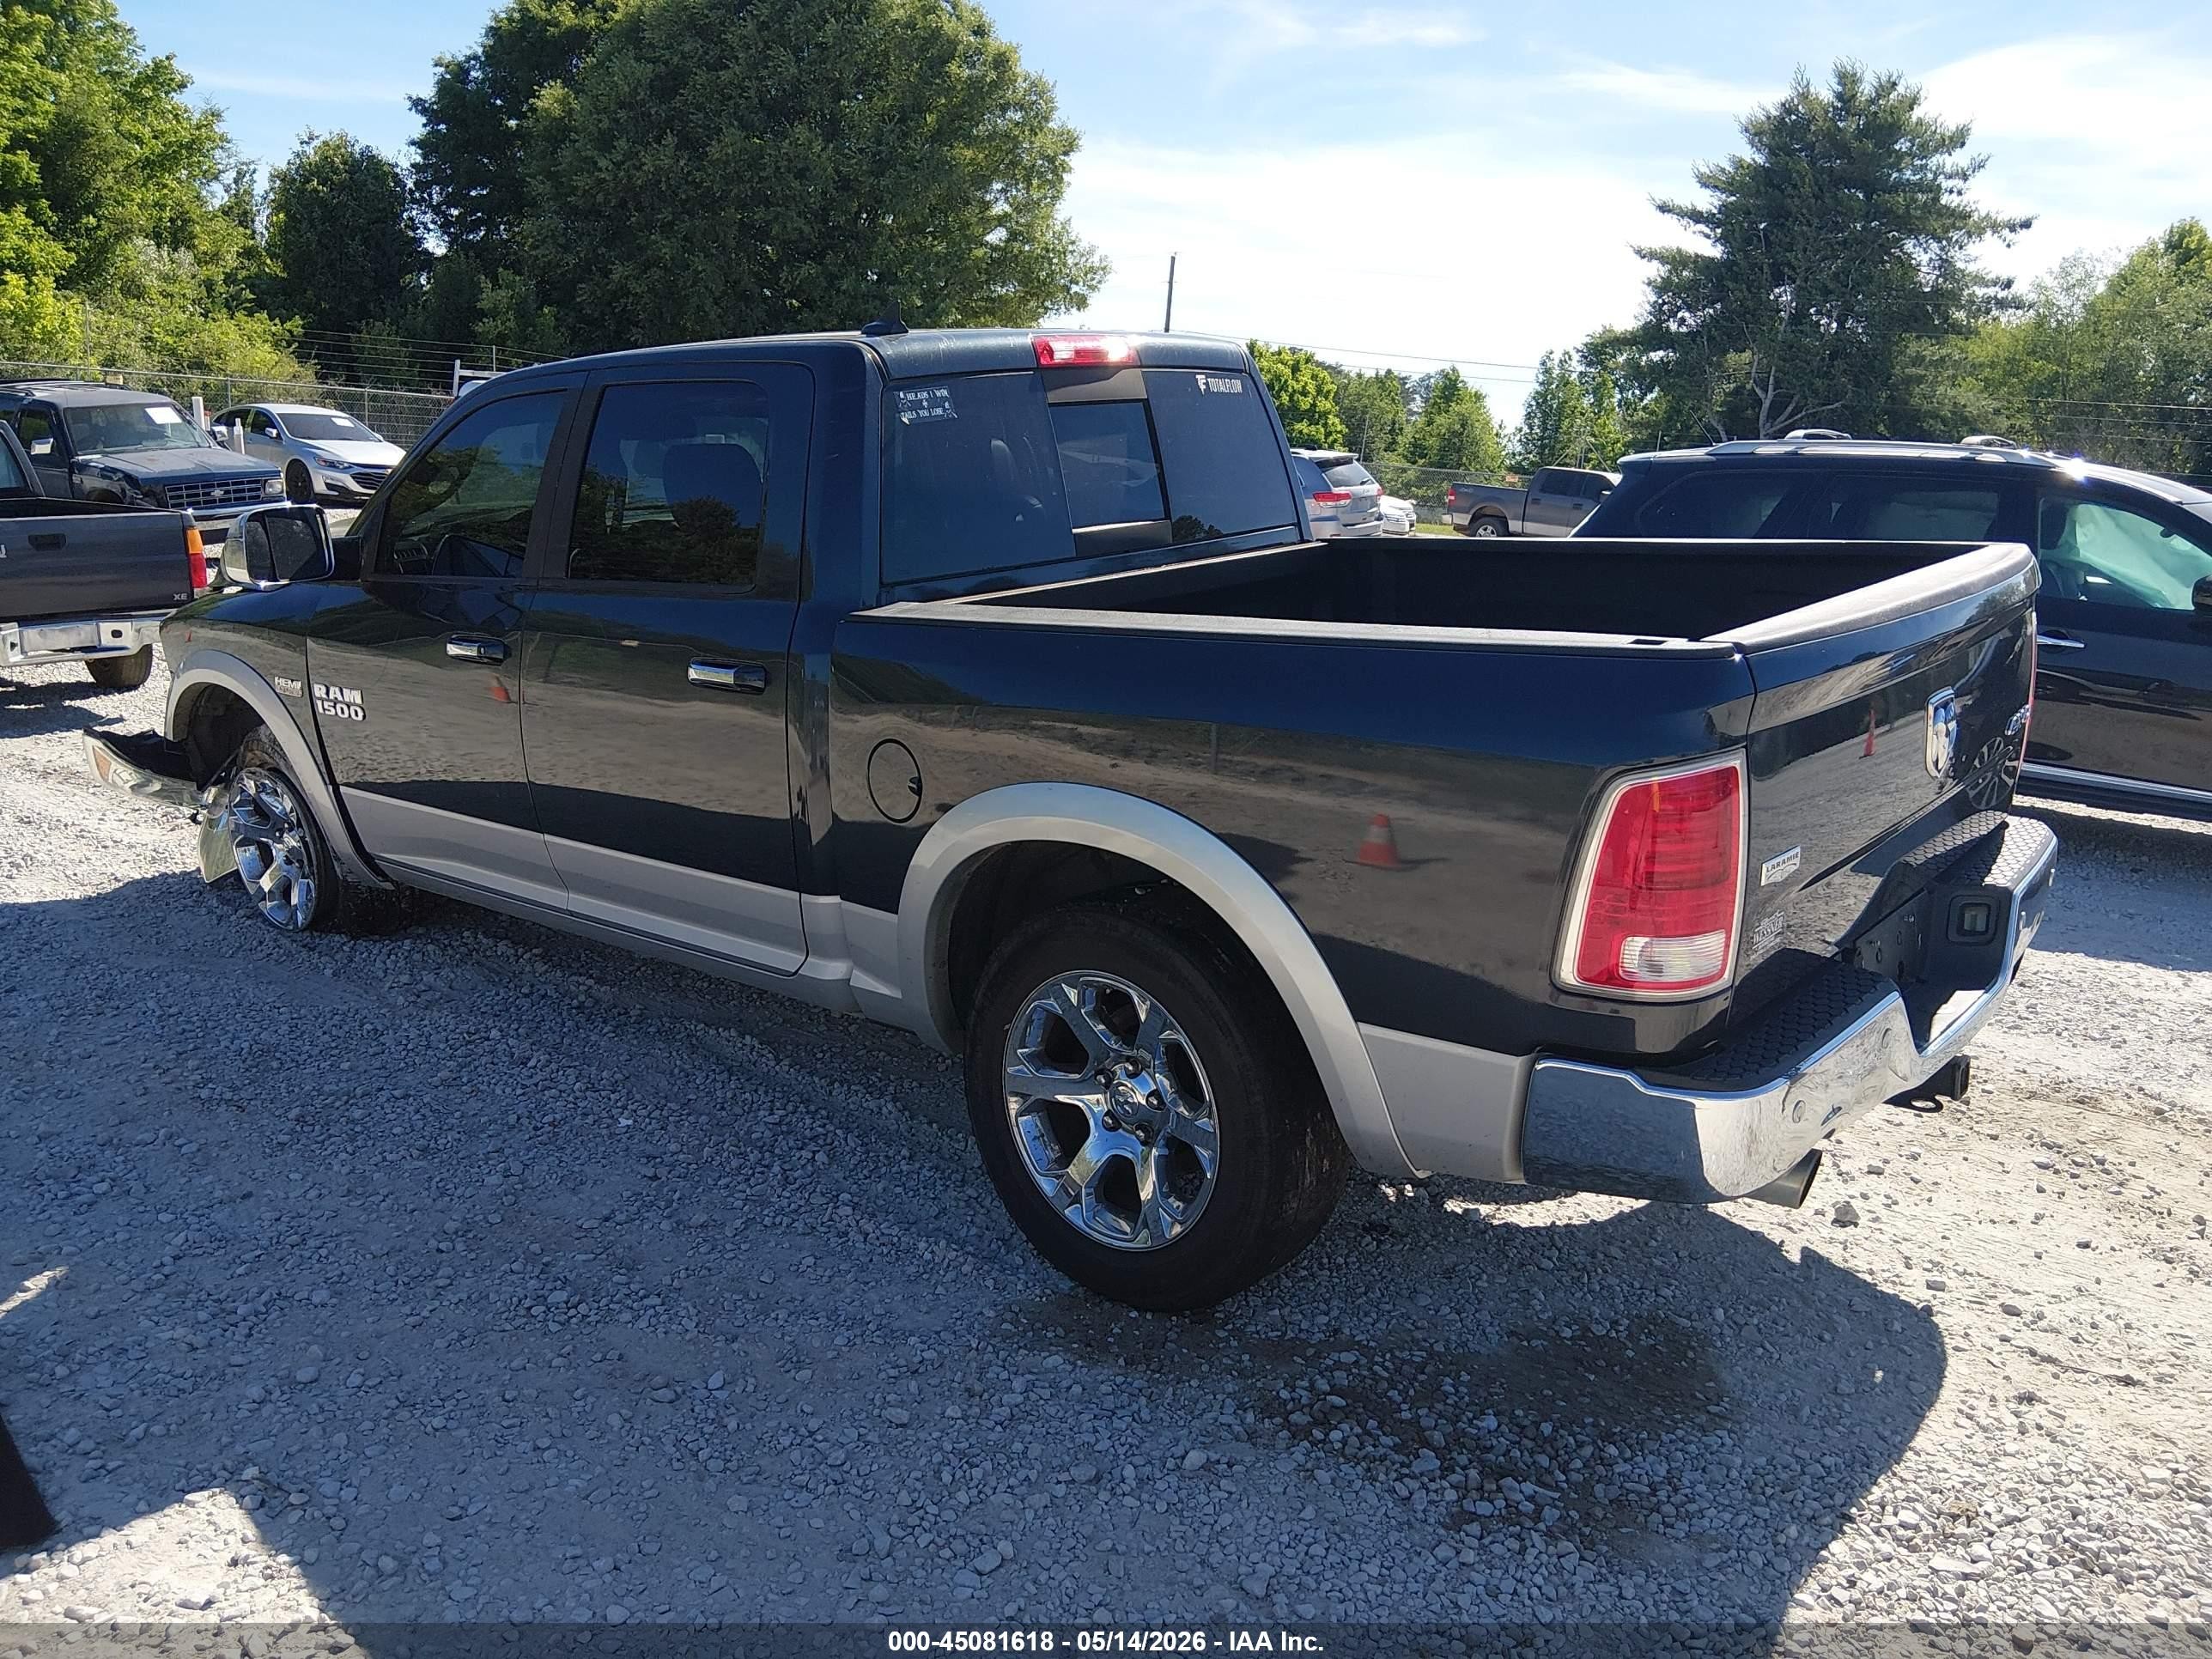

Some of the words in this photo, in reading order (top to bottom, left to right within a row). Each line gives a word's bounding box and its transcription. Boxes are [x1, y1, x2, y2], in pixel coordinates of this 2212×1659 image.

[1206, 378, 1243, 393] TOTALFLOW
[917, 408, 929, 417] YOU
[930, 407, 945, 416] LOSE
[173, 592, 187, 601] XE
[275, 676, 302, 690] HEMI
[313, 683, 362, 704] RAM
[315, 699, 365, 721] 1500
[1765, 851, 1800, 873] LARAMIE
